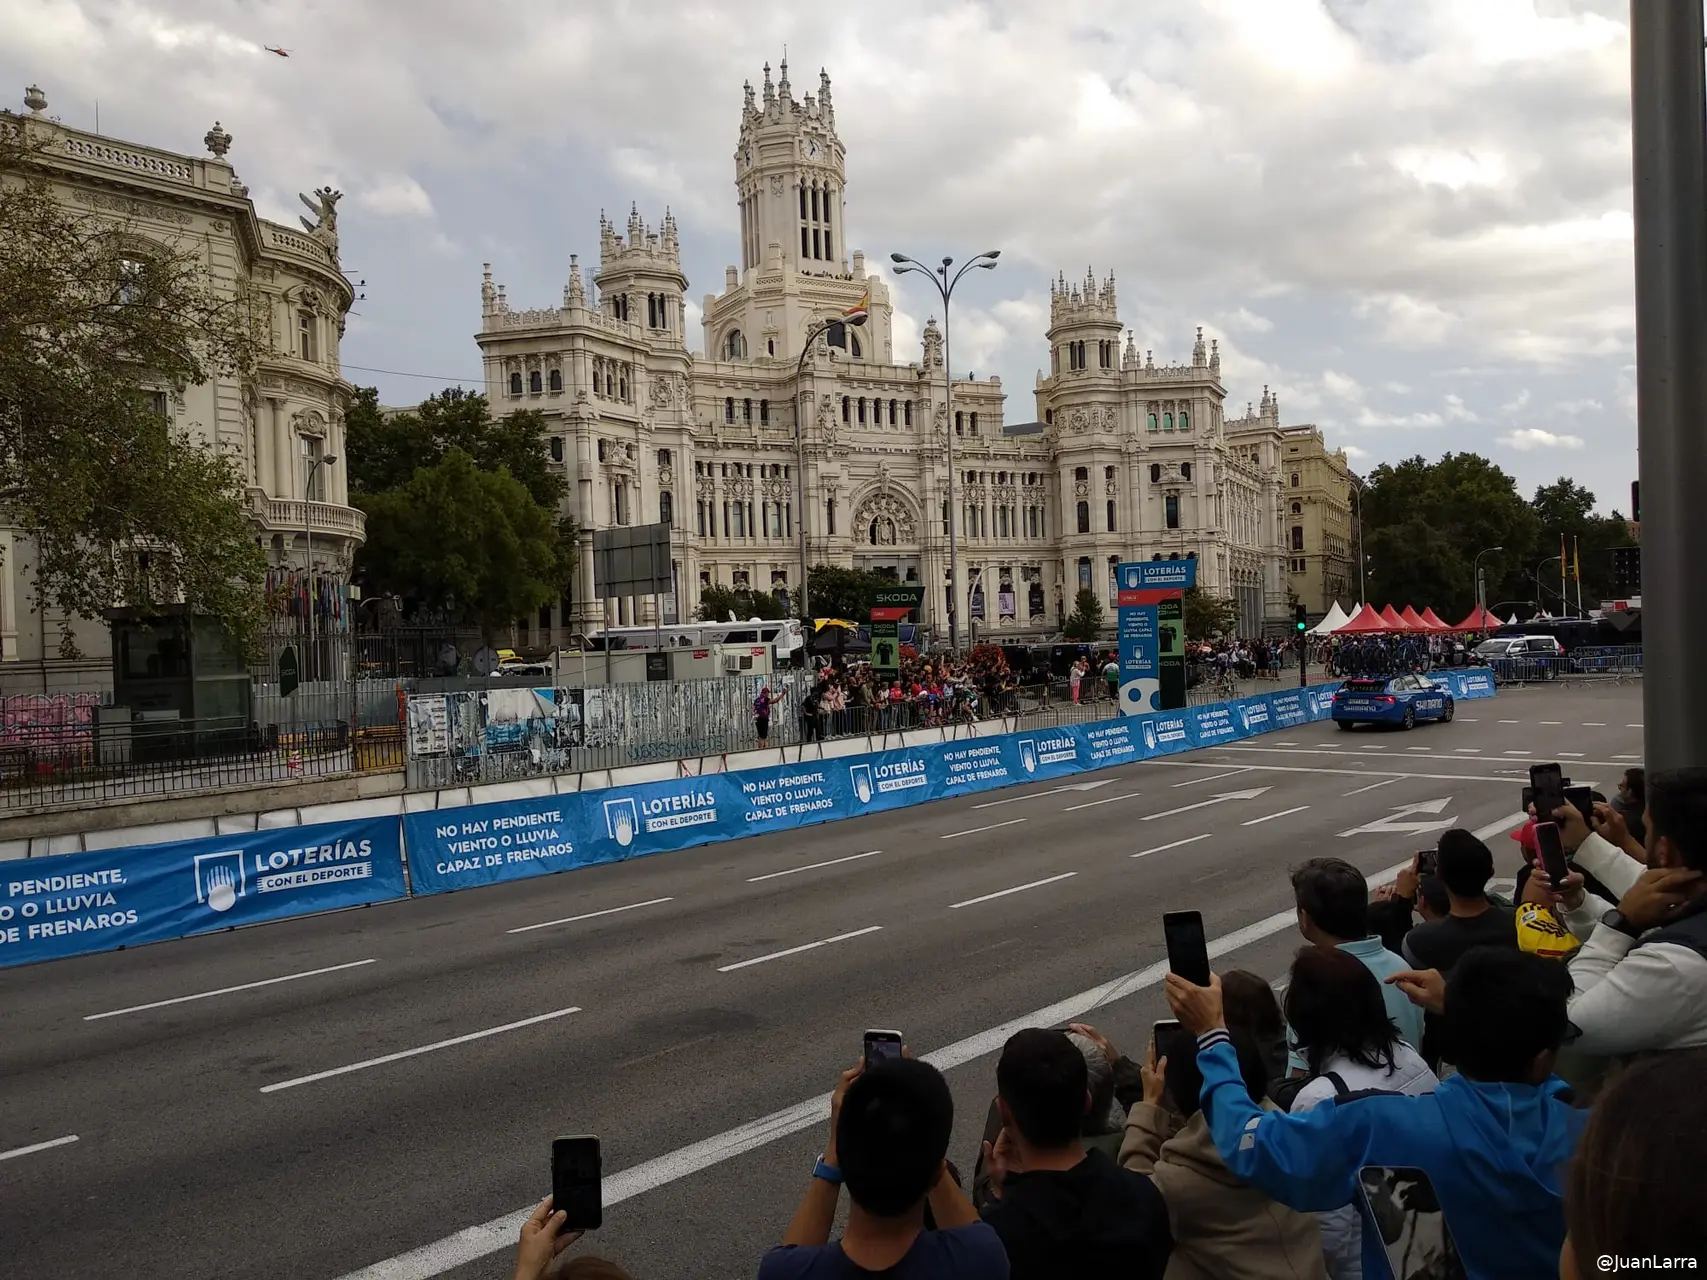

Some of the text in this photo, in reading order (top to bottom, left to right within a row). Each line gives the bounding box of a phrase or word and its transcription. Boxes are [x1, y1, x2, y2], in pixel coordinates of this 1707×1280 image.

[1144, 565, 1187, 576] LOTERÍAS
[1037, 735, 1076, 752] LOTERÍAS
[943, 753, 954, 762] NO
[954, 750, 967, 760] HAY
[949, 757, 1000, 773] VIENTO O LLUVIA
[874, 758, 925, 779] LOTERÍAS
[945, 767, 1008, 786] CAPAZ DE FRENAROS
[742, 772, 826, 794] NO HAY PENDIENTE,
[901, 776, 925, 786] DEPORTE
[641, 790, 715, 815] LOTERÍAS
[750, 787, 823, 807] VIENTO O LLUVIA
[651, 812, 712, 829] CON EL DEPORTE
[745, 798, 834, 822] CAPAZ DE FRENAROS
[436, 810, 564, 839] NO HAY PENDIENTE,
[447, 828, 559, 855] VIENTO O LLUVIA
[255, 839, 372, 872] LOTERÍAS
[436, 842, 573, 875] CAPAZ DE FRENAROS
[9, 868, 129, 897] PENDIENTE,
[266, 866, 363, 889] CON EL DEPORTE
[21, 902, 39, 918] O
[46, 891, 117, 915] LLUVIA
[28, 909, 139, 940] FRENAROS
